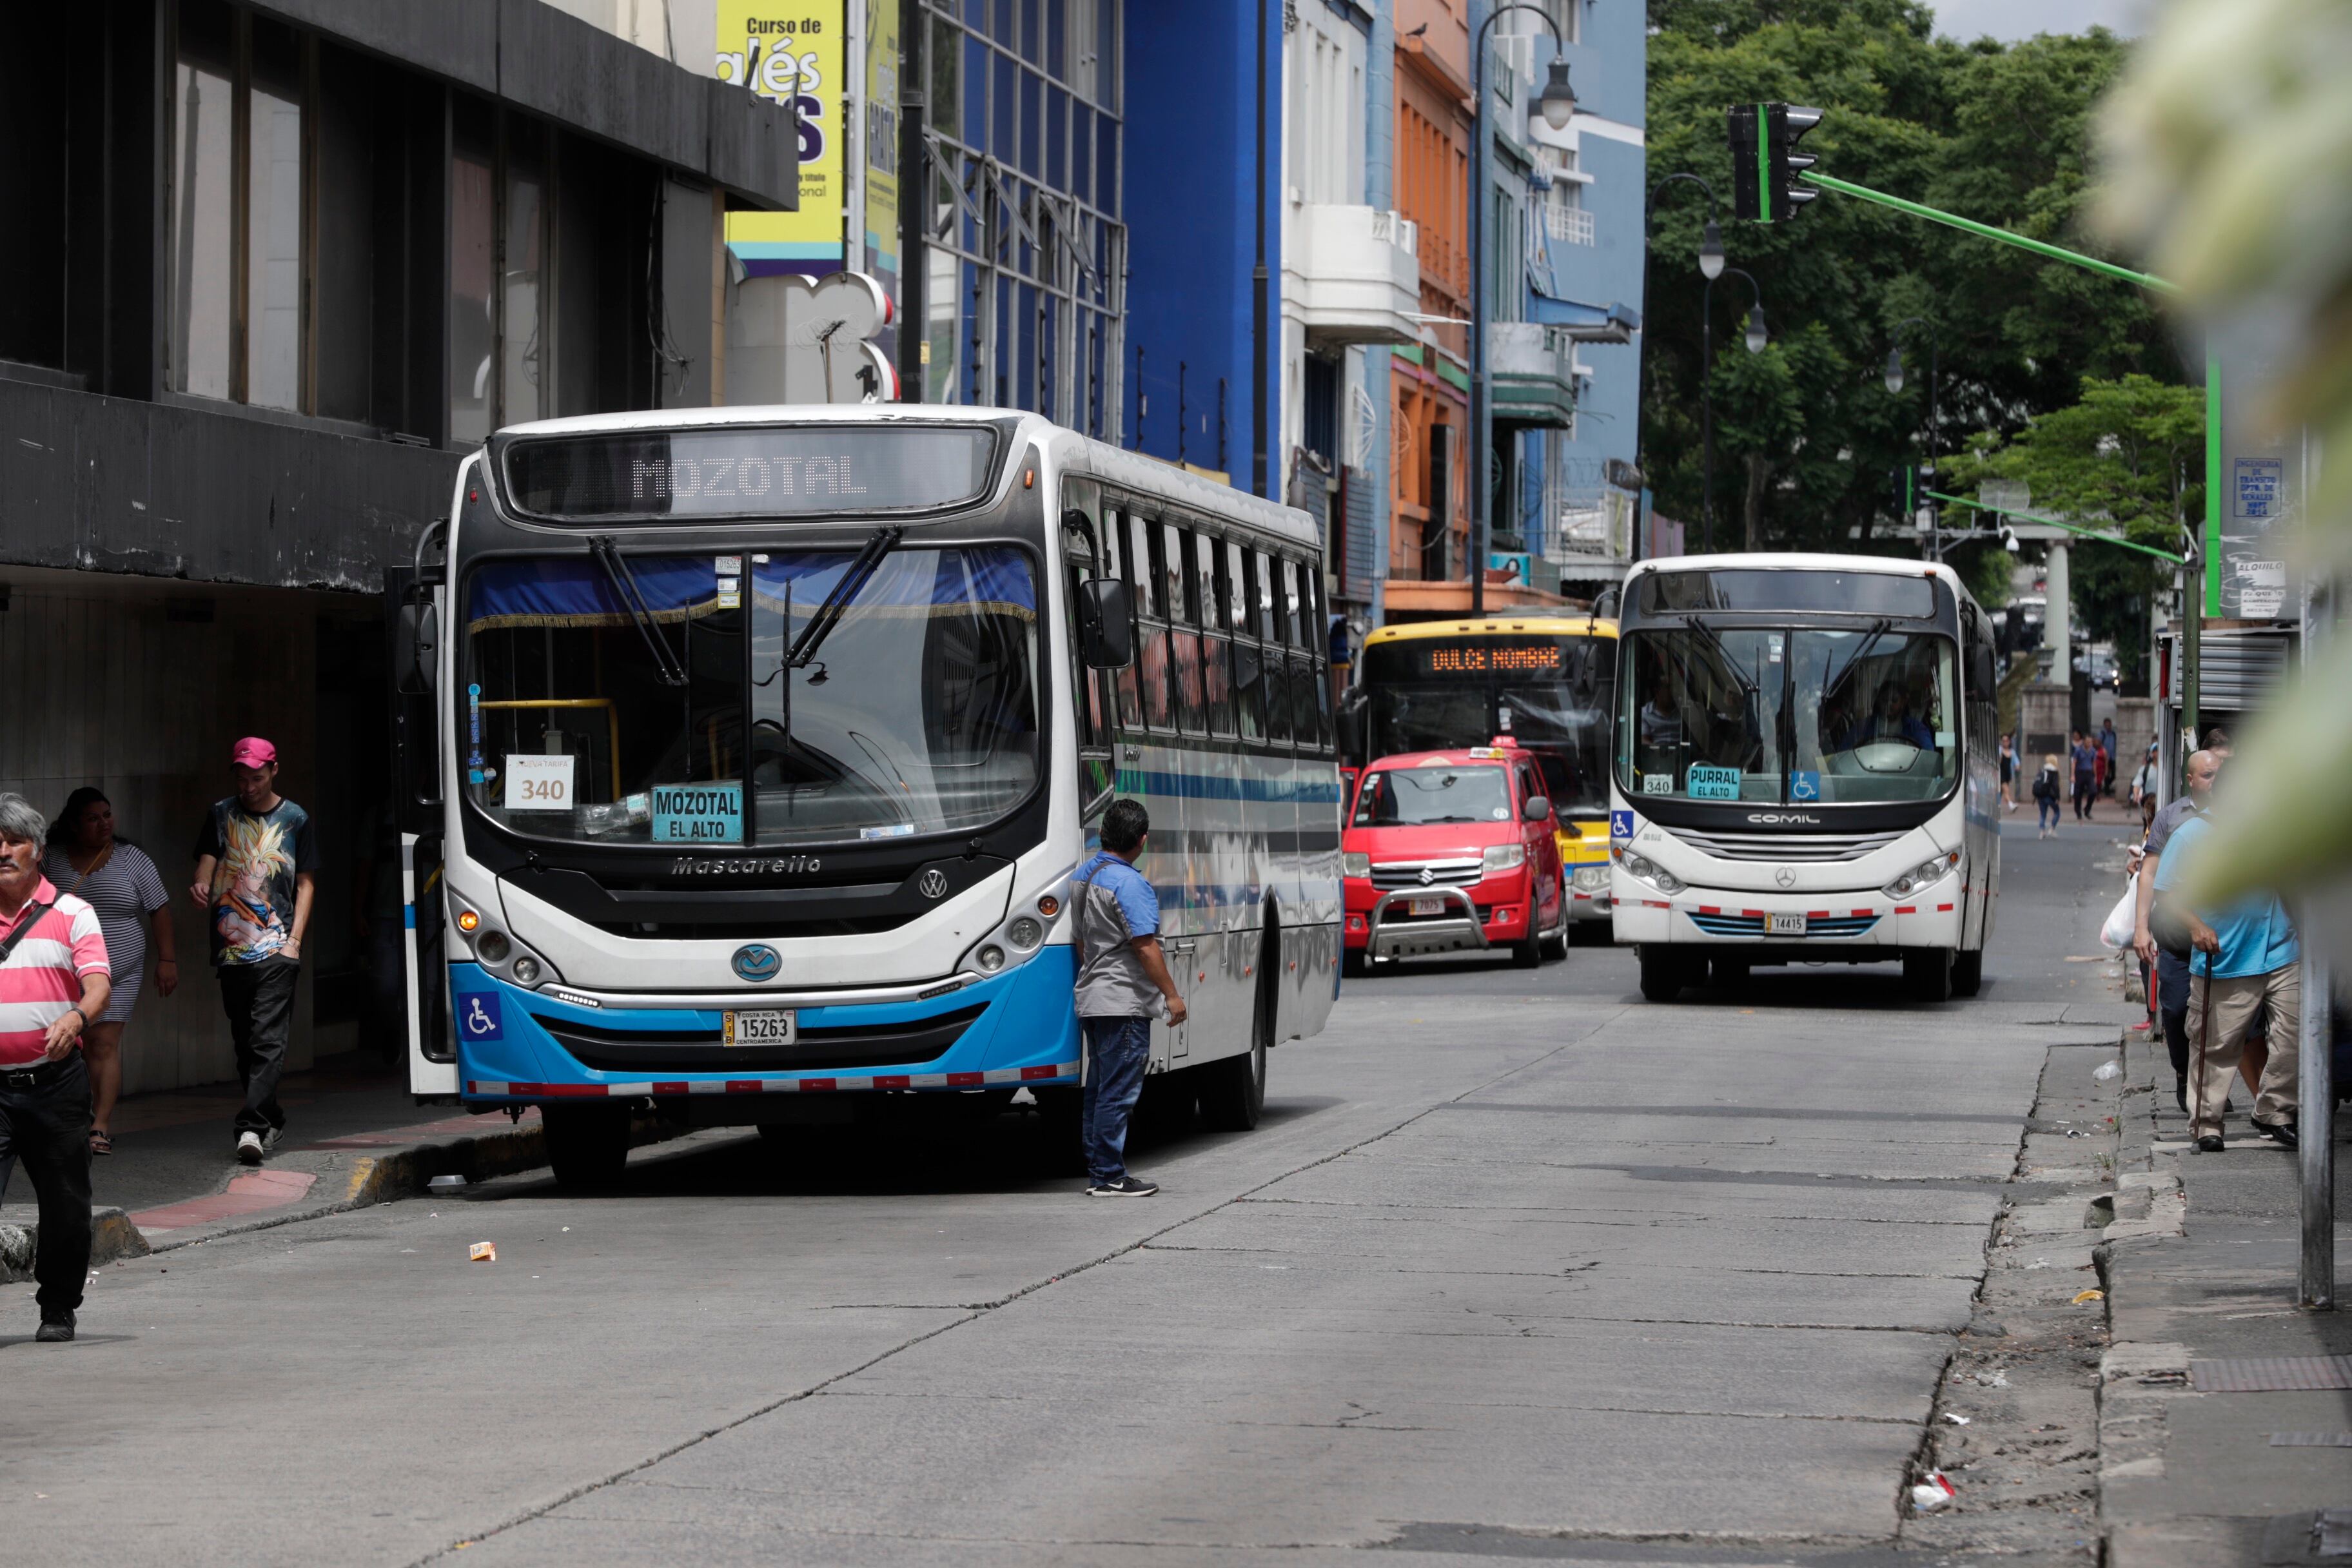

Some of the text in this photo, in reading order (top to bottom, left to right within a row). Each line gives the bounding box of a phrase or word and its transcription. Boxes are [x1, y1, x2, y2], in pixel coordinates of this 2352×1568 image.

[747, 17, 821, 34] Curso de
[632, 455, 867, 498] MOZOTAL
[2239, 562, 2283, 571] ALQUILO
[1433, 647, 1560, 670] DULCE NOMBRE
[1690, 770, 1738, 784] PURRAL
[522, 779, 564, 799] 340
[1647, 781, 1669, 792] 340
[1698, 787, 1729, 797] EL ALTO
[656, 792, 738, 815] MOZOTAL
[1747, 814, 1820, 823] COMIL
[670, 821, 725, 838] EL ALTO
[671, 856, 821, 874] Mascarello
[1419, 899, 1438, 910] 7075
[1776, 918, 1801, 929] 14415
[741, 1018, 788, 1038] 15263
